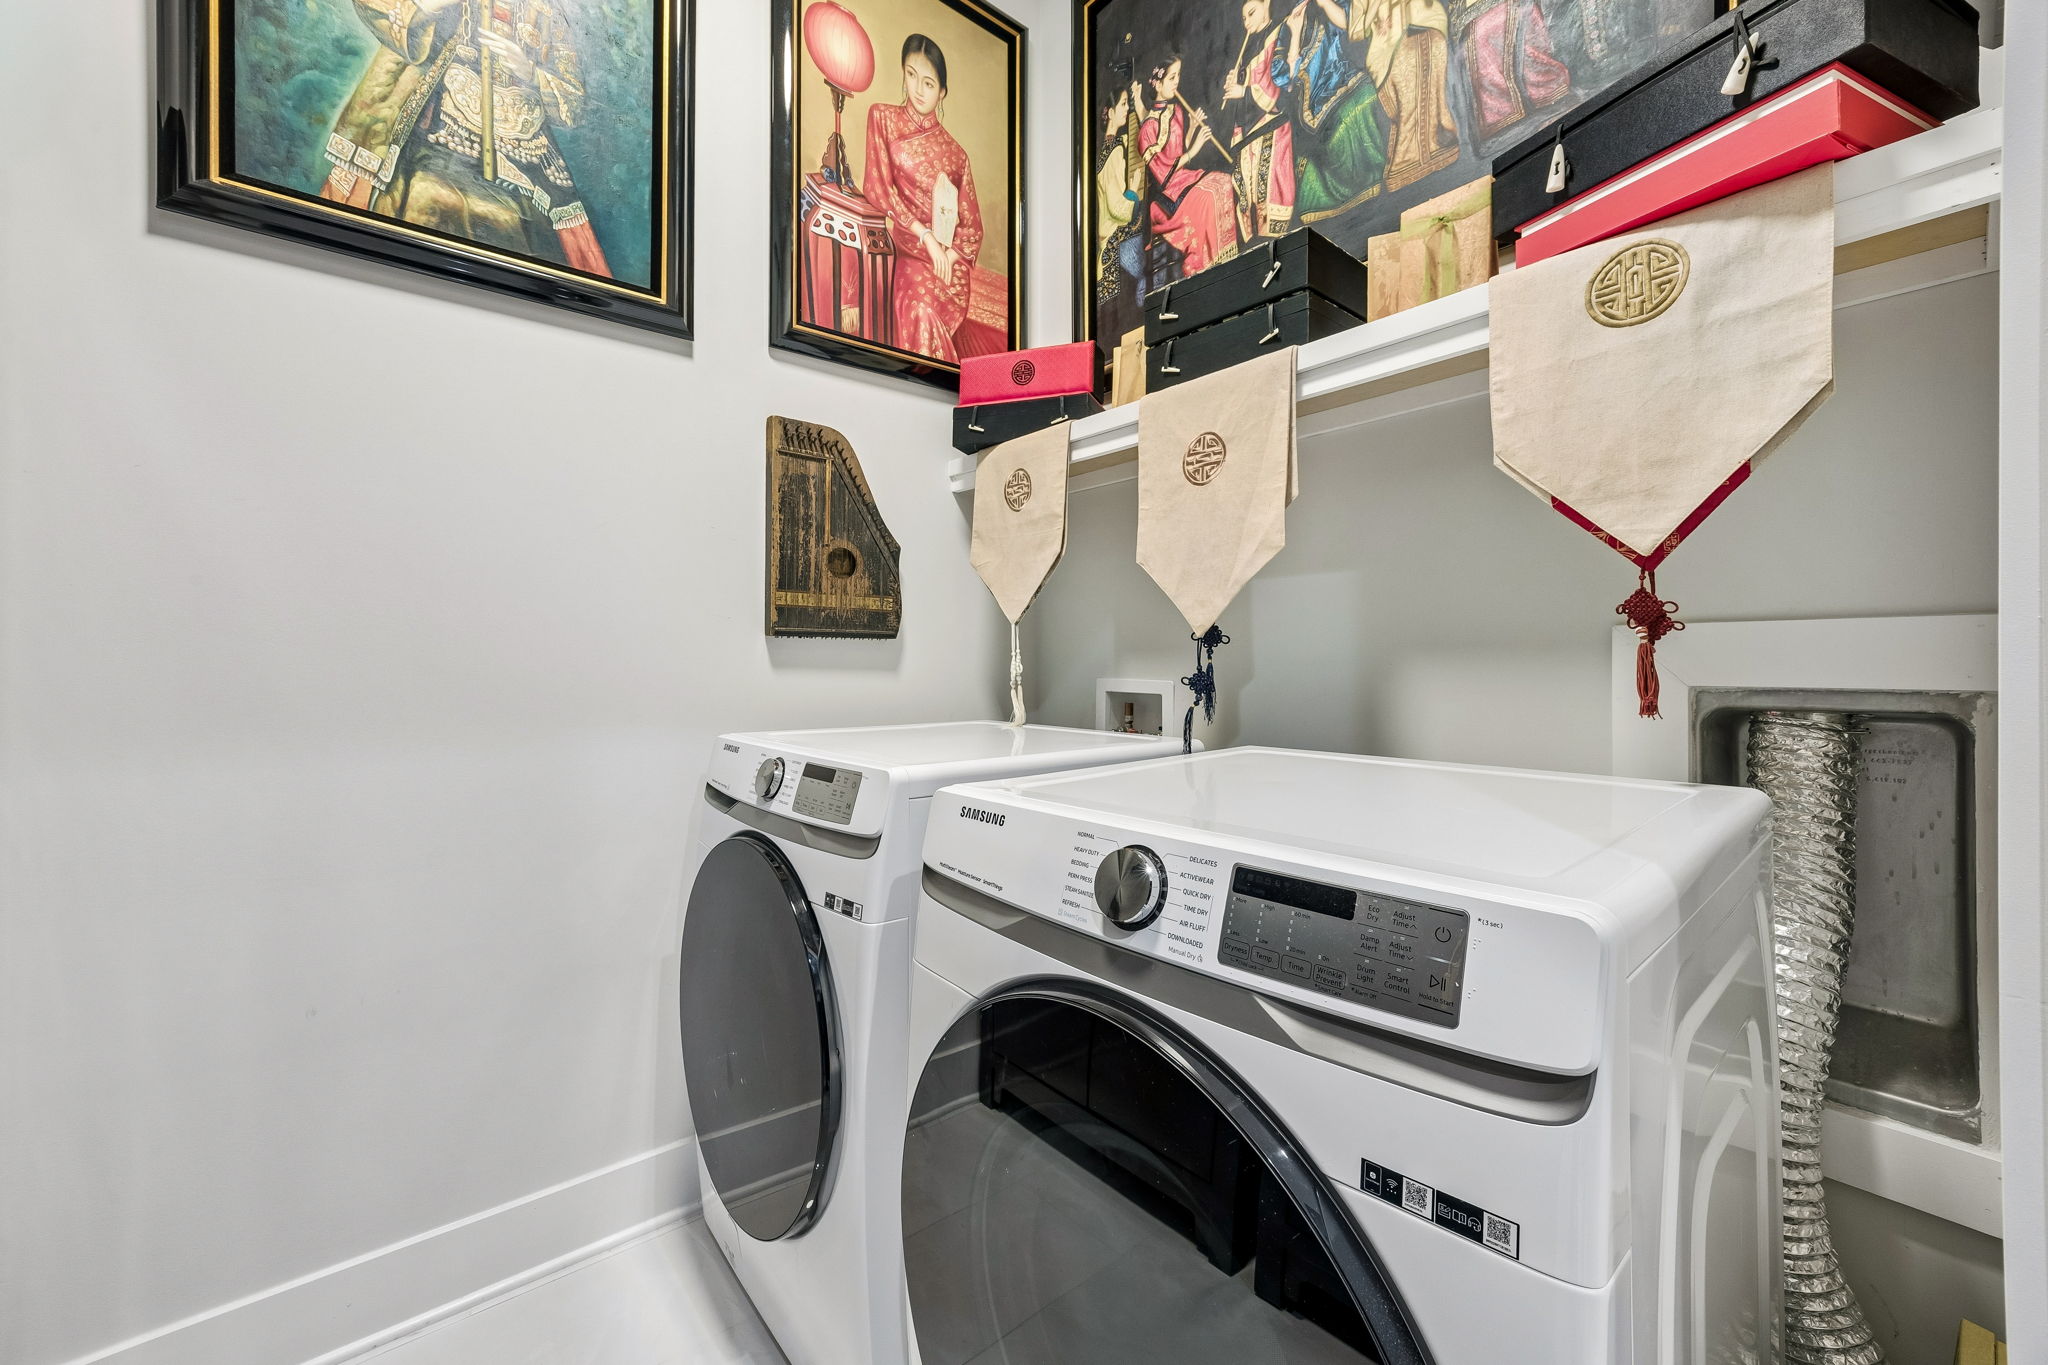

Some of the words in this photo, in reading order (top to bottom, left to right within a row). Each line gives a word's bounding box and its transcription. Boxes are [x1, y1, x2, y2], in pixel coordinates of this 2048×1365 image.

[960, 806, 1006, 827] SAMSUNG
[1077, 831, 1095, 840] NORMAL
[1071, 859, 1089, 868] BEDDING
[1189, 856, 1218, 868] DELICATES
[1068, 872, 1080, 880] PERM
[1080, 875, 1093, 883] PRESS
[1180, 872, 1215, 885] ACTIVEWEAR
[1183, 888, 1199, 898] QUICK
[1199, 892, 1211, 901] DRY
[1062, 899, 1081, 909] REFRESH
[1368, 905, 1380, 914] Eco
[1184, 904, 1198, 913] TIME
[1197, 907, 1209, 917] DRY
[1393, 911, 1416, 922] Adjust
[1366, 912, 1379, 923] Dry
[1392, 918, 1410, 929] Time
[1179, 920, 1188, 928] AIR
[1189, 922, 1206, 932] FLUFF
[1167, 932, 1204, 949] DOWNLOADED
[1360, 933, 1380, 945] Damp
[1224, 942, 1248, 955] Dryness
[1360, 942, 1378, 953] Alert
[1389, 941, 1412, 952] Adjust
[1169, 946, 1186, 957] Manual
[1186, 951, 1196, 962] Dry
[1321, 955, 1330, 963] On
[1388, 949, 1406, 960] Time
[1288, 961, 1305, 973] Time
[1317, 966, 1343, 980] Wrinkle
[1356, 963, 1376, 975] Drum
[1316, 974, 1342, 987] Prevent
[1356, 973, 1374, 984] Light
[1387, 973, 1409, 985] Smart
[1383, 981, 1410, 995] Control
[1418, 992, 1431, 1001] Hold
[1439, 999, 1454, 1007] Start
